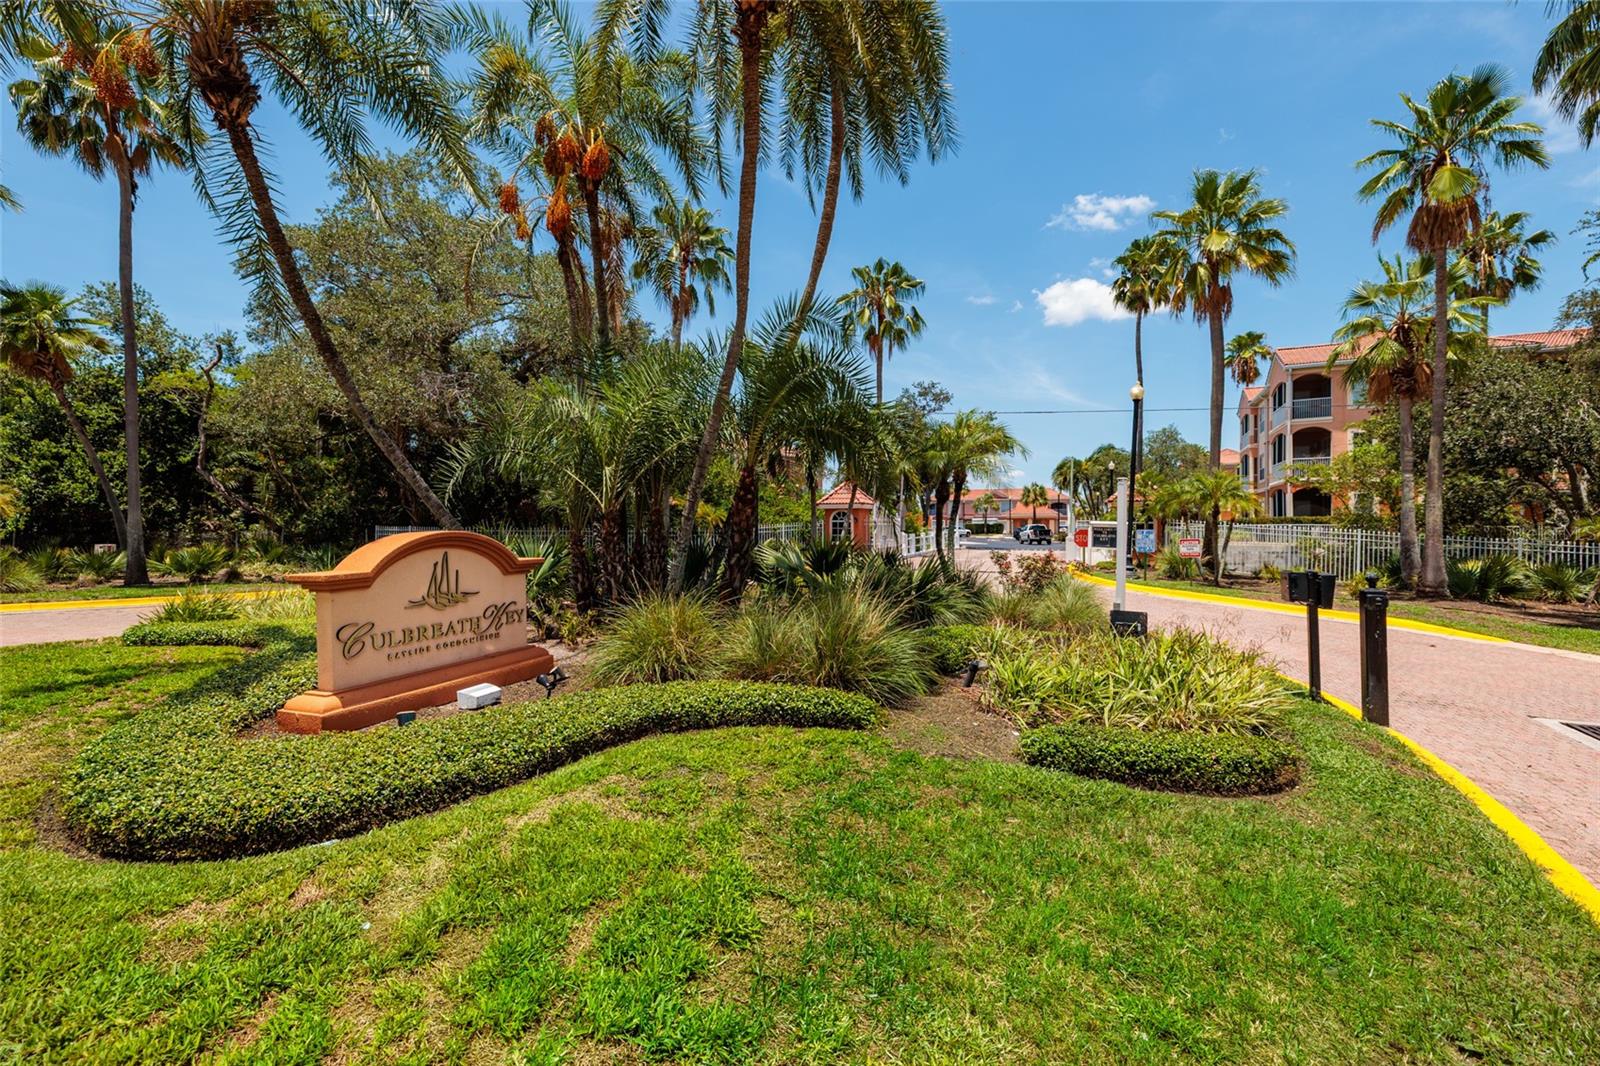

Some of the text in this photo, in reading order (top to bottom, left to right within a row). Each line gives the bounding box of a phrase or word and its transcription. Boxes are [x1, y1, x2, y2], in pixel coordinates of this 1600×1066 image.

[1075, 535, 1088, 543] STO
[336, 601, 524, 660] CULBREATH KEY
